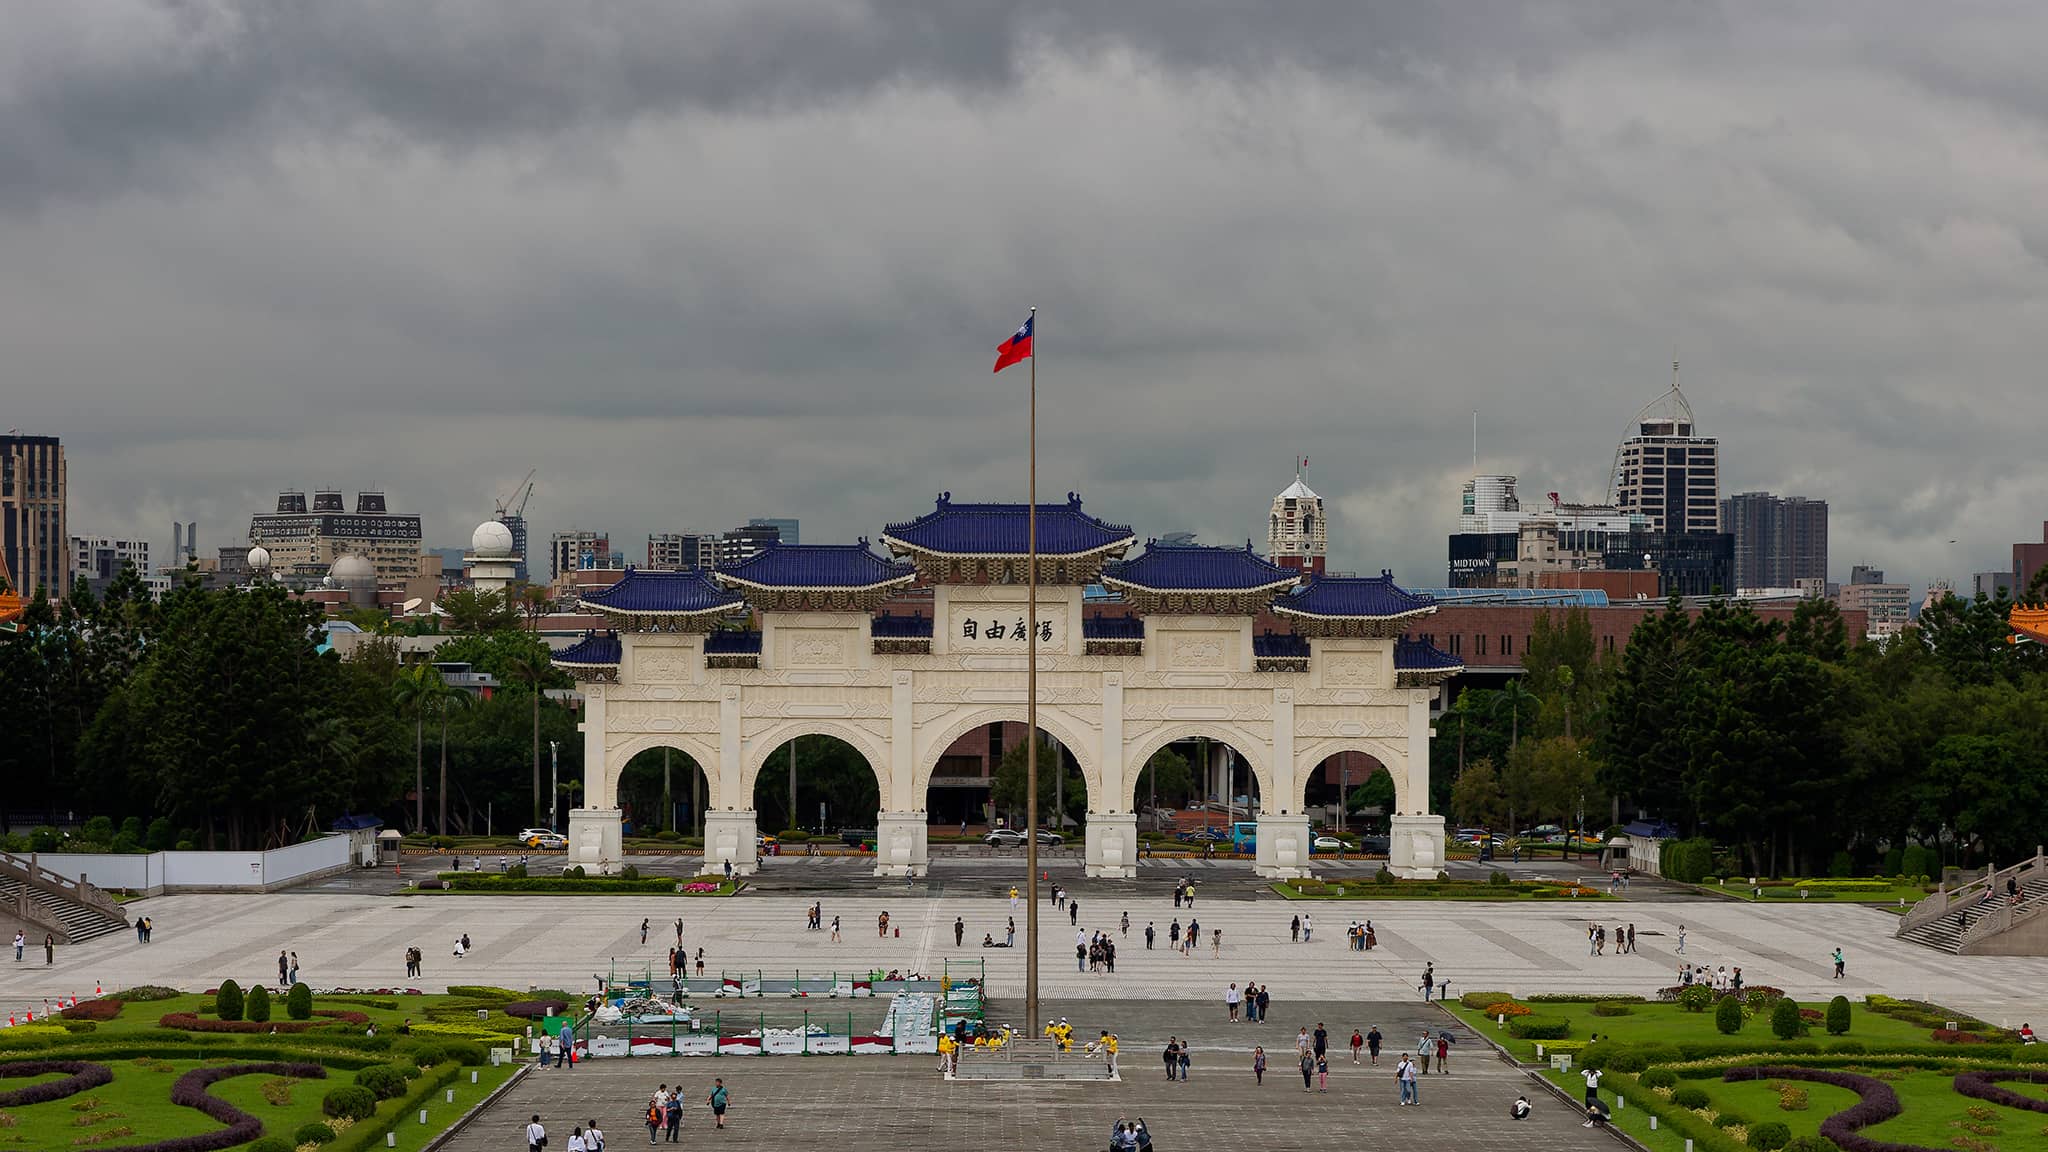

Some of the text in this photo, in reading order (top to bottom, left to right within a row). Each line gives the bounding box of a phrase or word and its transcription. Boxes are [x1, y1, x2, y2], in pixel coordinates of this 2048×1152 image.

[1454, 559, 1490, 568] MIDTOWN
[963, 617, 1052, 641] 自由廣場
